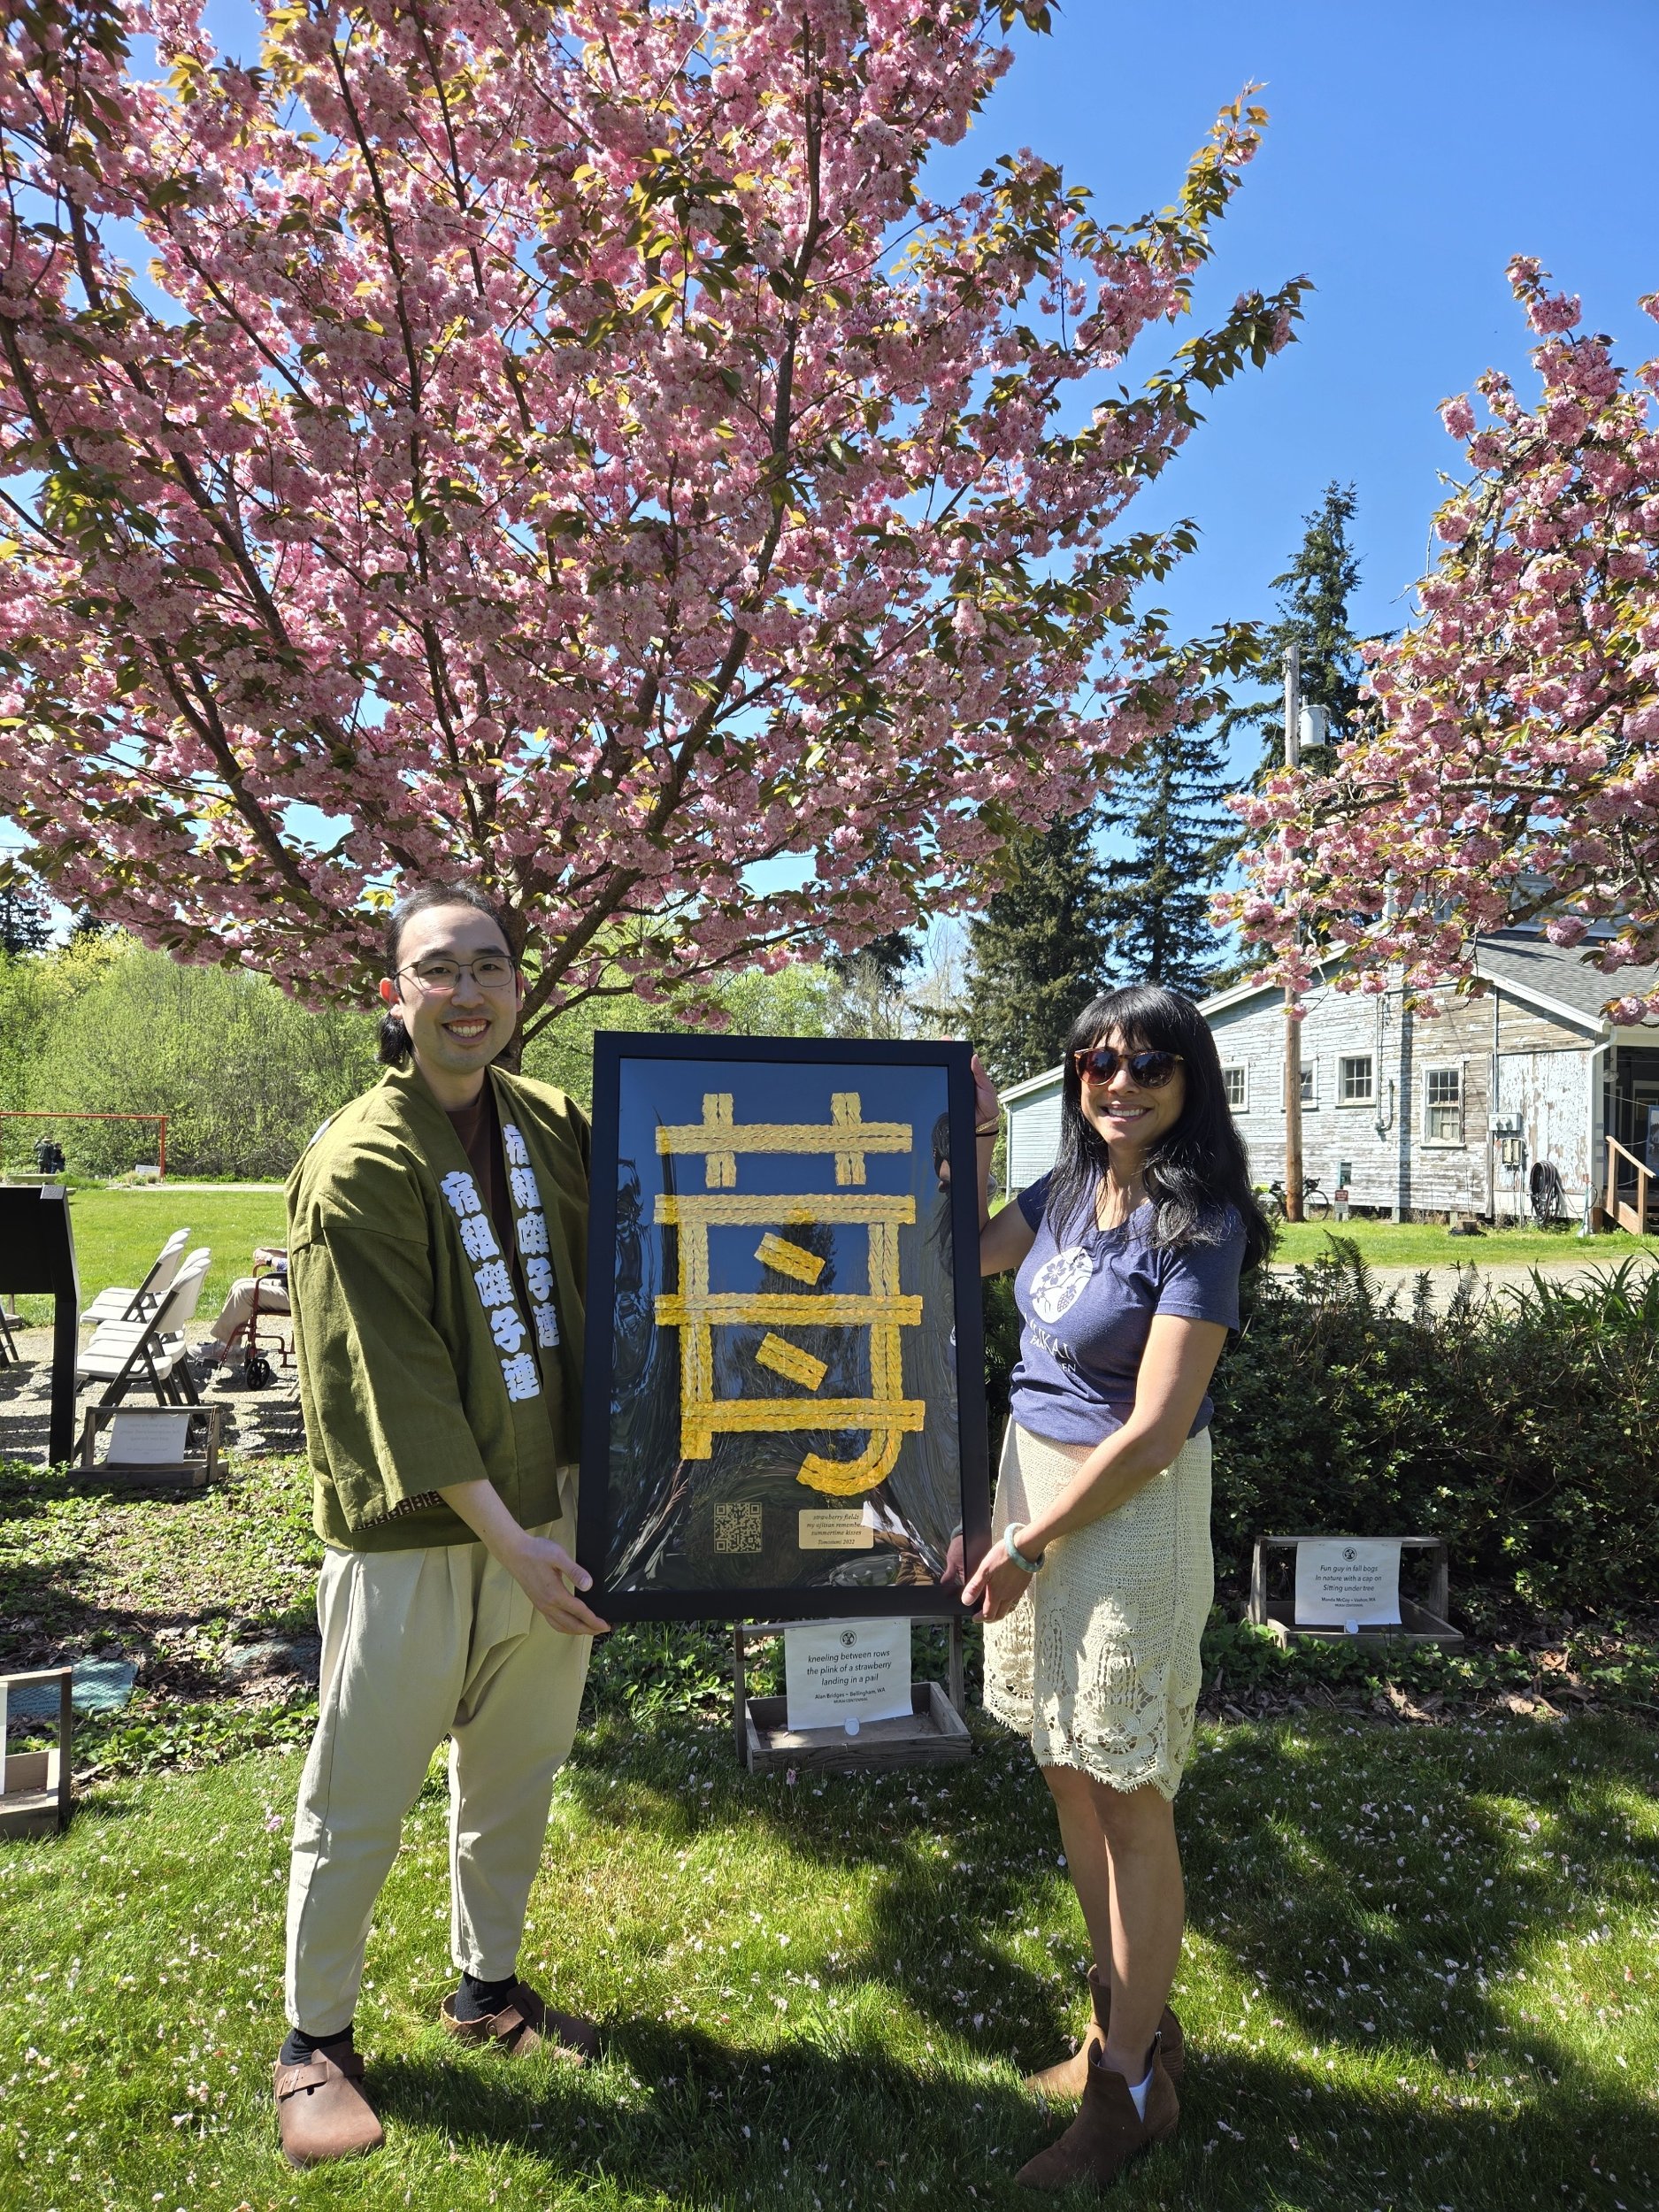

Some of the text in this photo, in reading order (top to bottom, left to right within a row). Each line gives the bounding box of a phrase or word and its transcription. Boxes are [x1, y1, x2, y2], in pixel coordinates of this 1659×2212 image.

[1323, 1584, 1343, 1593] Sitting
[808, 1654, 839, 1663] kneeling
[807, 1667, 819, 1676] the
[820, 1664, 839, 1676] plink
[855, 1661, 892, 1671] strawberry
[821, 1678, 849, 1686] landing
[864, 1673, 879, 1685] pail
[826, 1691, 845, 1700] Bridges
